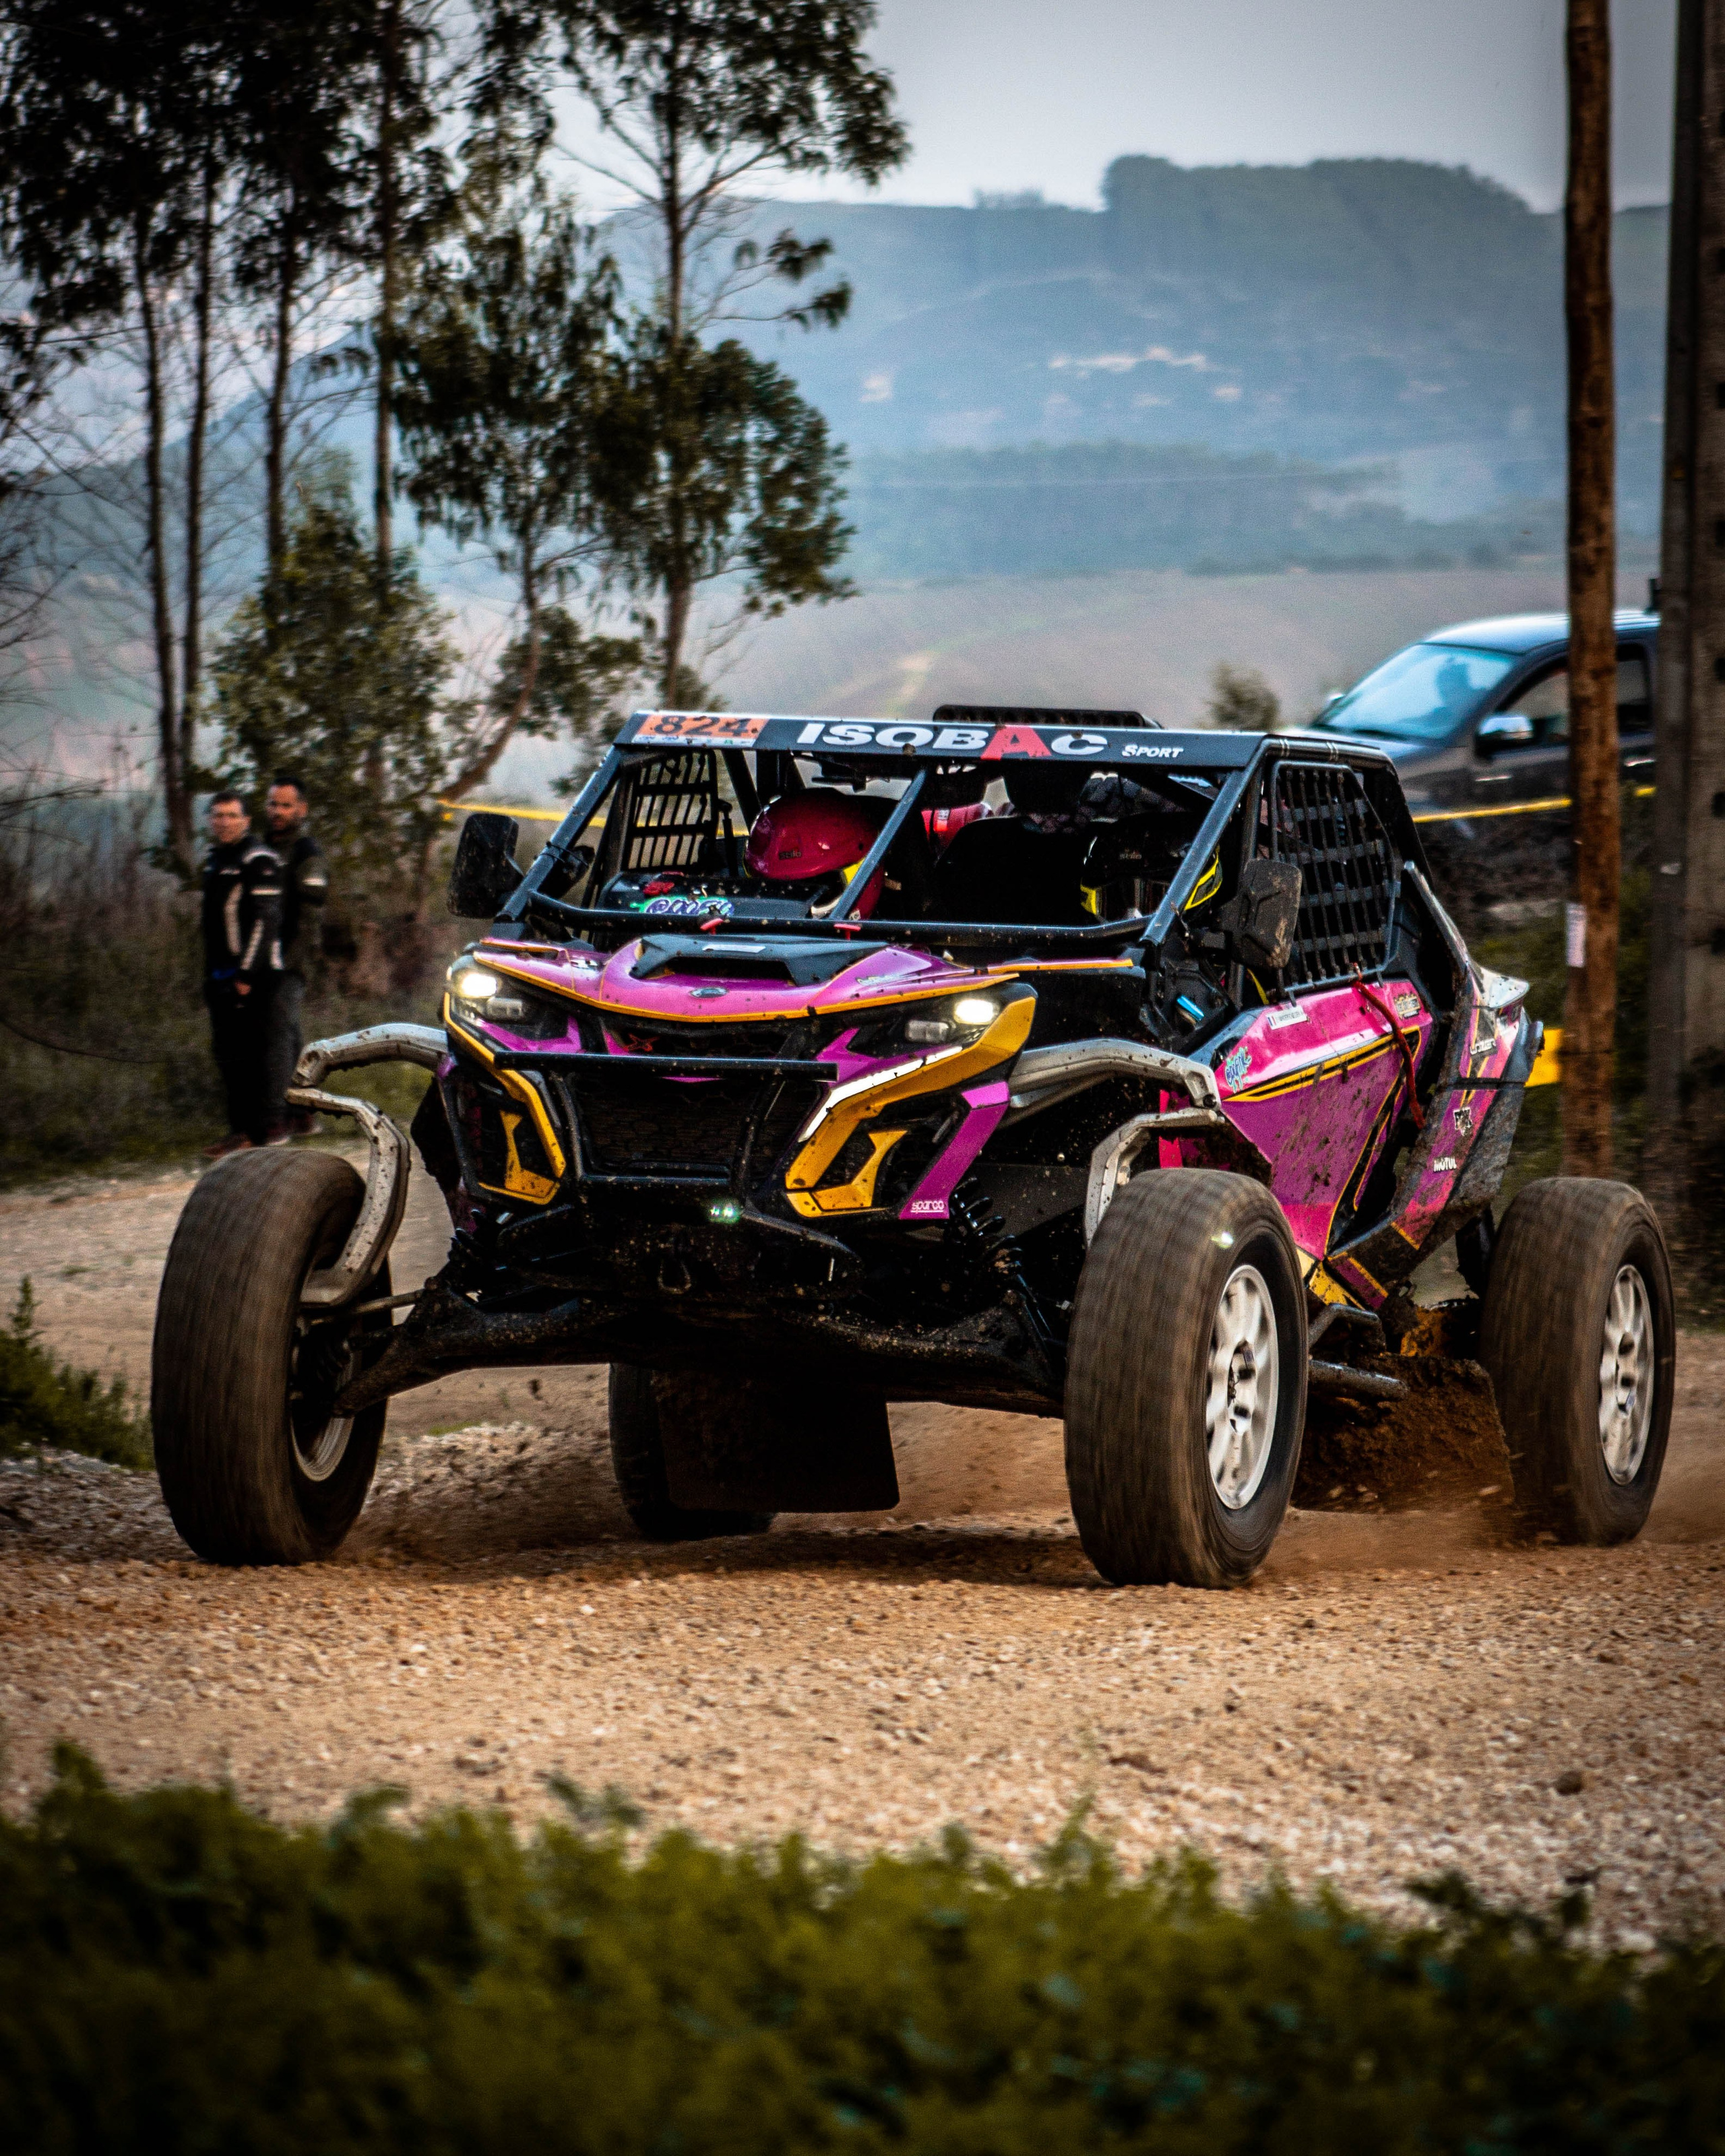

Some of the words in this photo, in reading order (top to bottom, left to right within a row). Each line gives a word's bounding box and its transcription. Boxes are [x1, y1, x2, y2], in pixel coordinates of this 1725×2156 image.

[654, 716, 751, 736] 824
[796, 723, 1108, 761] ISOBAC
[1433, 1156, 1457, 1172] MOTUL
[911, 1200, 945, 1214] sparco
